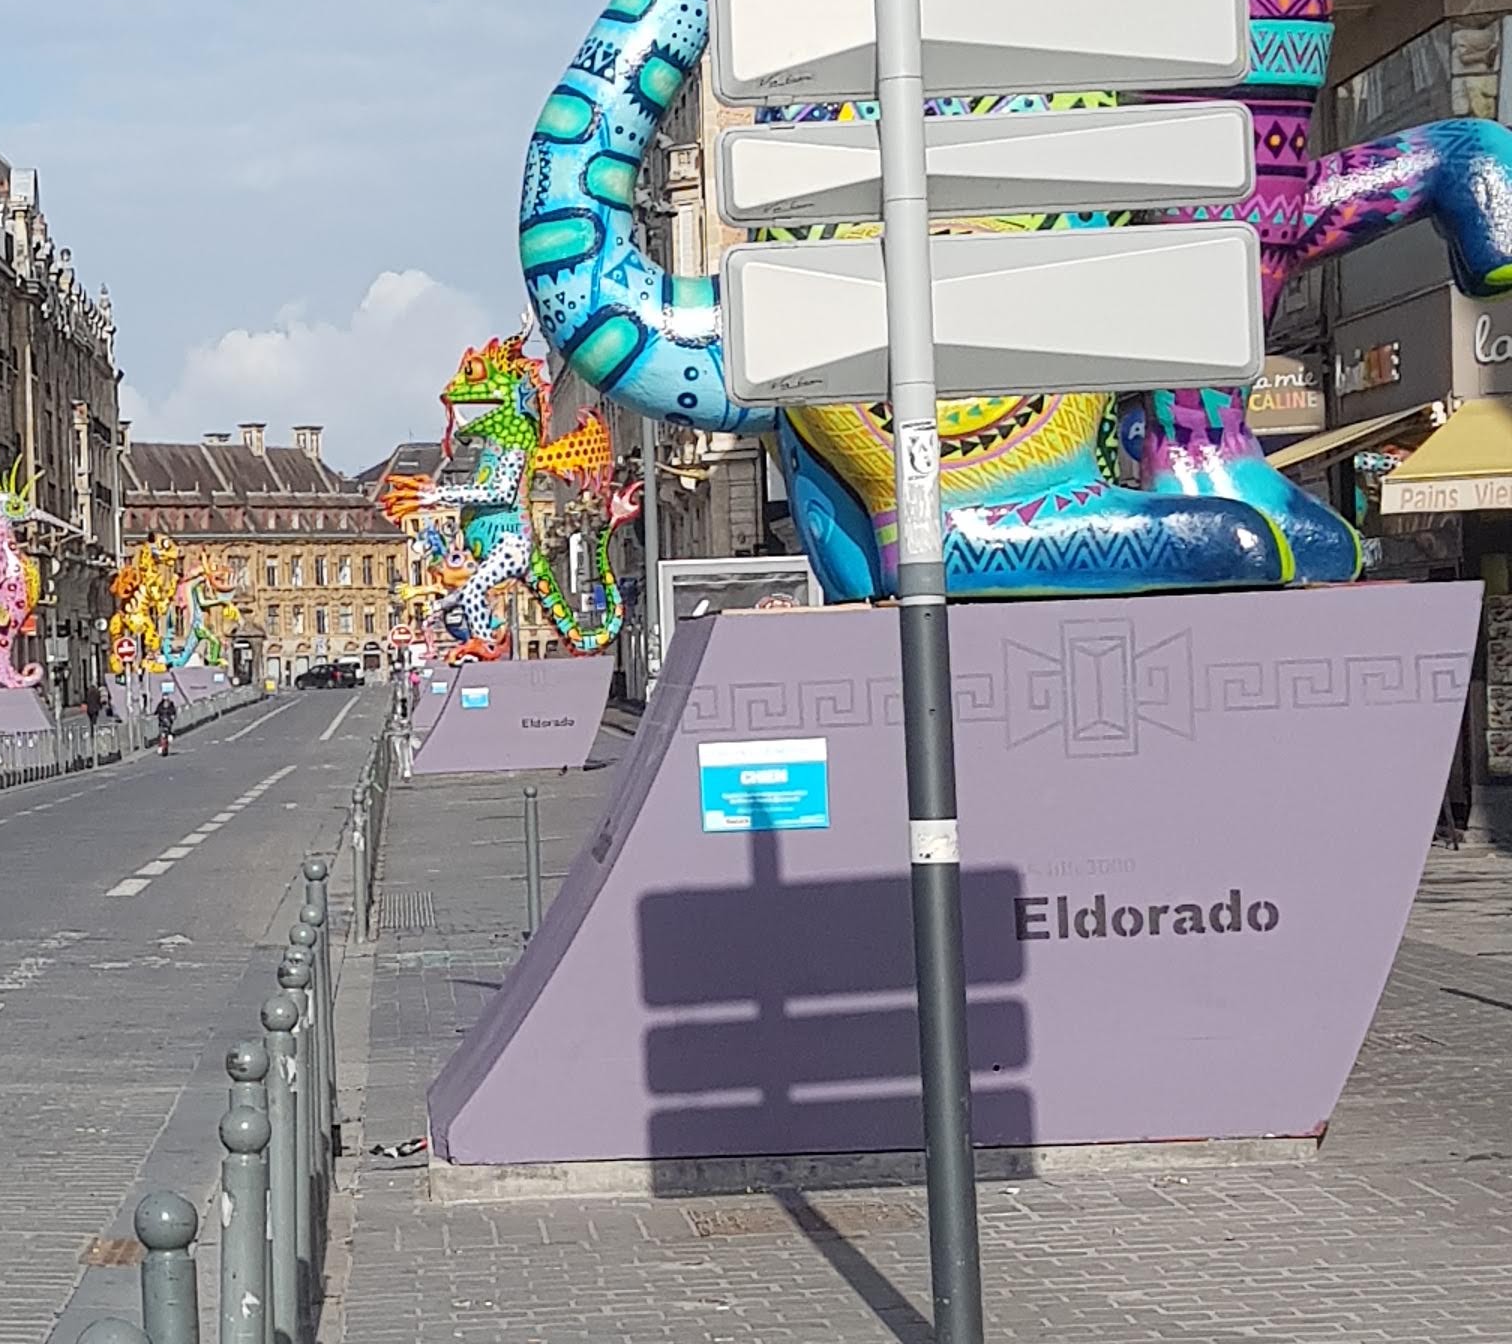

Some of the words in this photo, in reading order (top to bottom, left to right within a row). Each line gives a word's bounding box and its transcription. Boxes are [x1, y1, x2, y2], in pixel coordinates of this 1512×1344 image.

[1400, 485, 1459, 510] Pains
[521, 716, 575, 728] Eldorado
[1013, 888, 1280, 941] Eldorado
